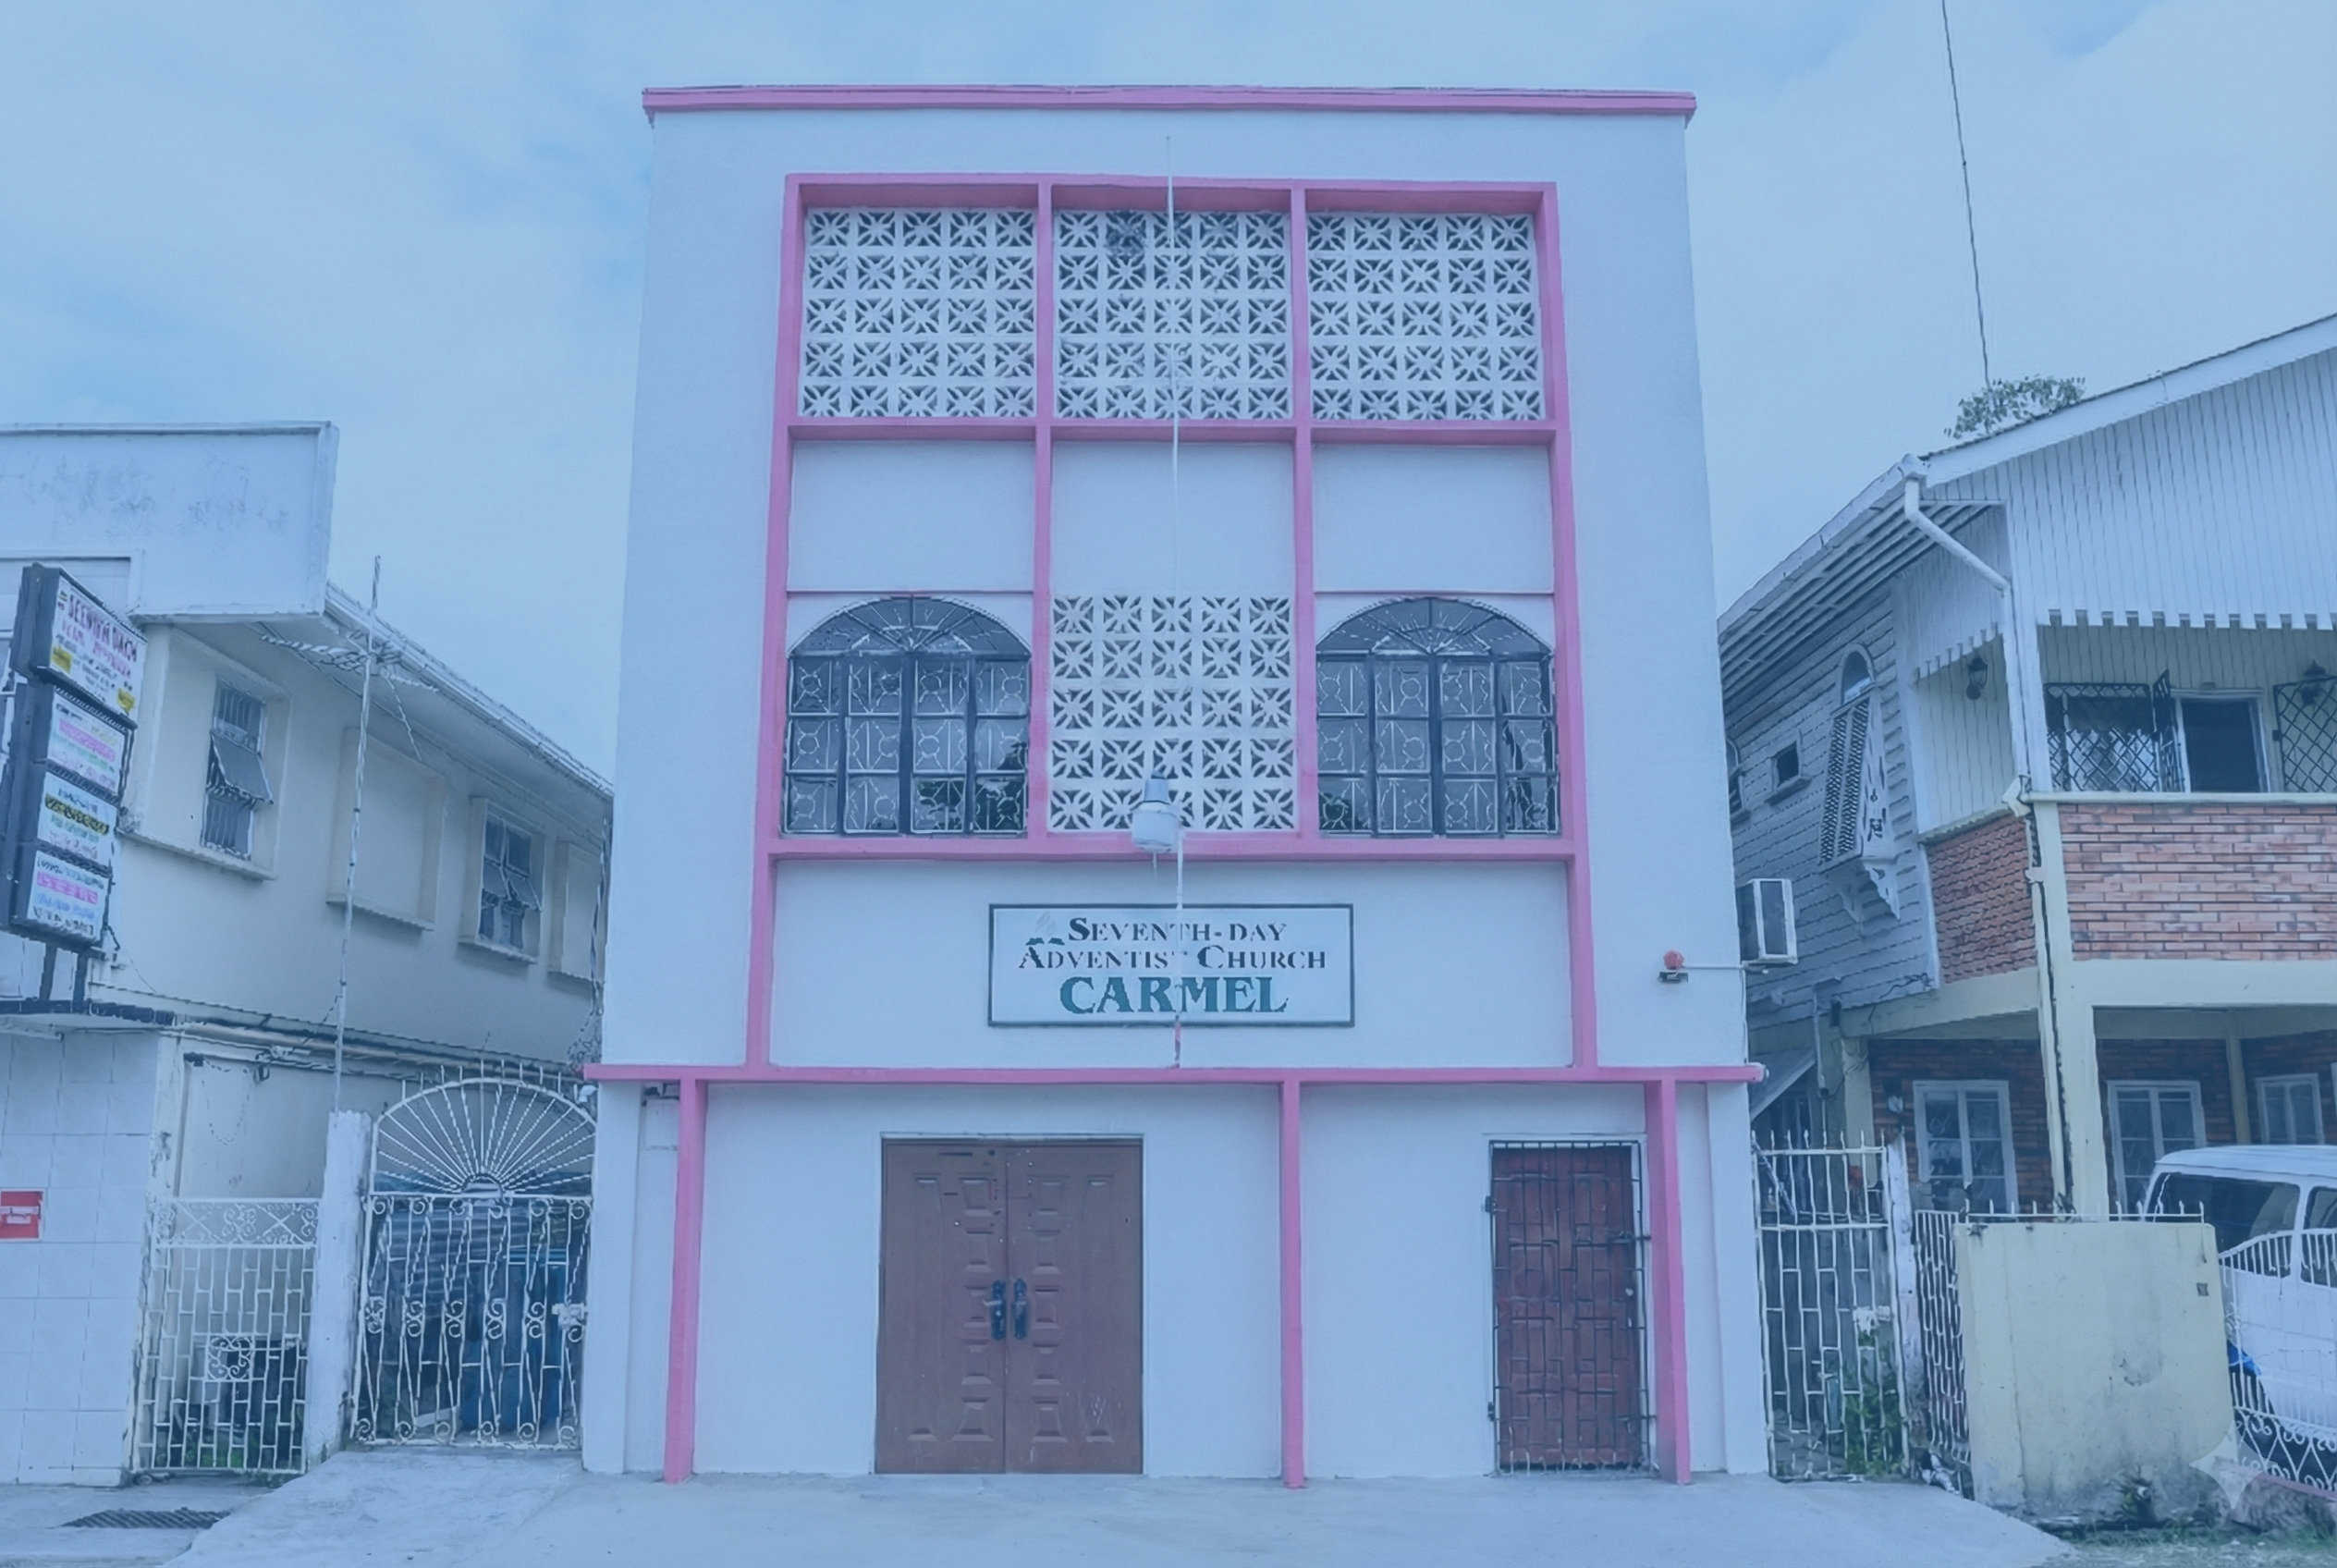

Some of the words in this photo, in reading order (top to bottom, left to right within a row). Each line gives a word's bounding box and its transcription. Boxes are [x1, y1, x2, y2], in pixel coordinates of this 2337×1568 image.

[1019, 946, 1187, 969] ADVENTIS
[1197, 945, 1326, 969] CHURCH
[1060, 976, 1289, 1013] CARMEL
